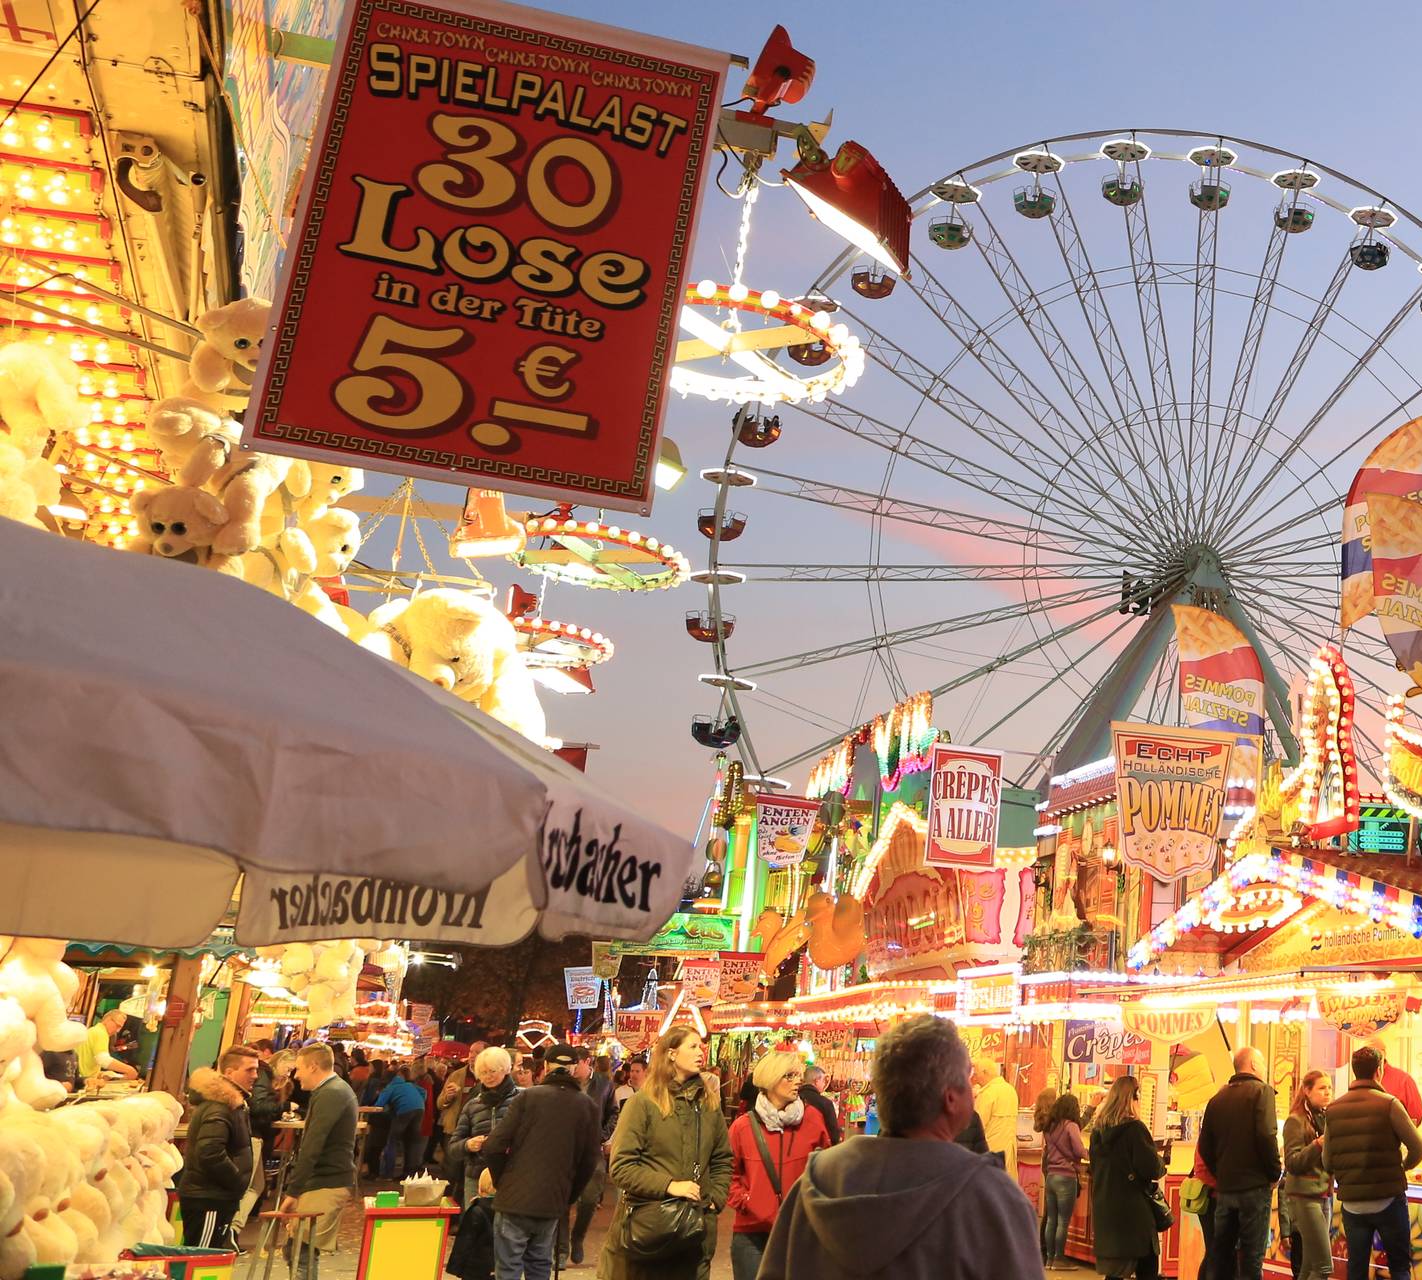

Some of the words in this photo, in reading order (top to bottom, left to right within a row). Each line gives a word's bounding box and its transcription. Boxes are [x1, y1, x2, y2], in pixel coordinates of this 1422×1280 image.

[376, 22, 485, 51] CHINATOWN
[485, 46, 591, 75] CHINATOWN
[368, 42, 688, 154] SPIELPALAST
[591, 70, 693, 98] CHINATOWN
[416, 112, 616, 230] 30
[374, 272, 417, 305] in
[430, 284, 503, 321] der
[514, 297, 603, 340] Tüte
[1136, 743, 1211, 764] ECHT
[1122, 759, 1223, 779] HOLLÄNDISCHE
[931, 765, 1000, 807] CRÊPES
[1118, 775, 1226, 837] POMMES
[759, 816, 810, 826] ANGELN
[946, 807, 994, 842] ALLER
[1133, 1012, 1204, 1035] POMMES
